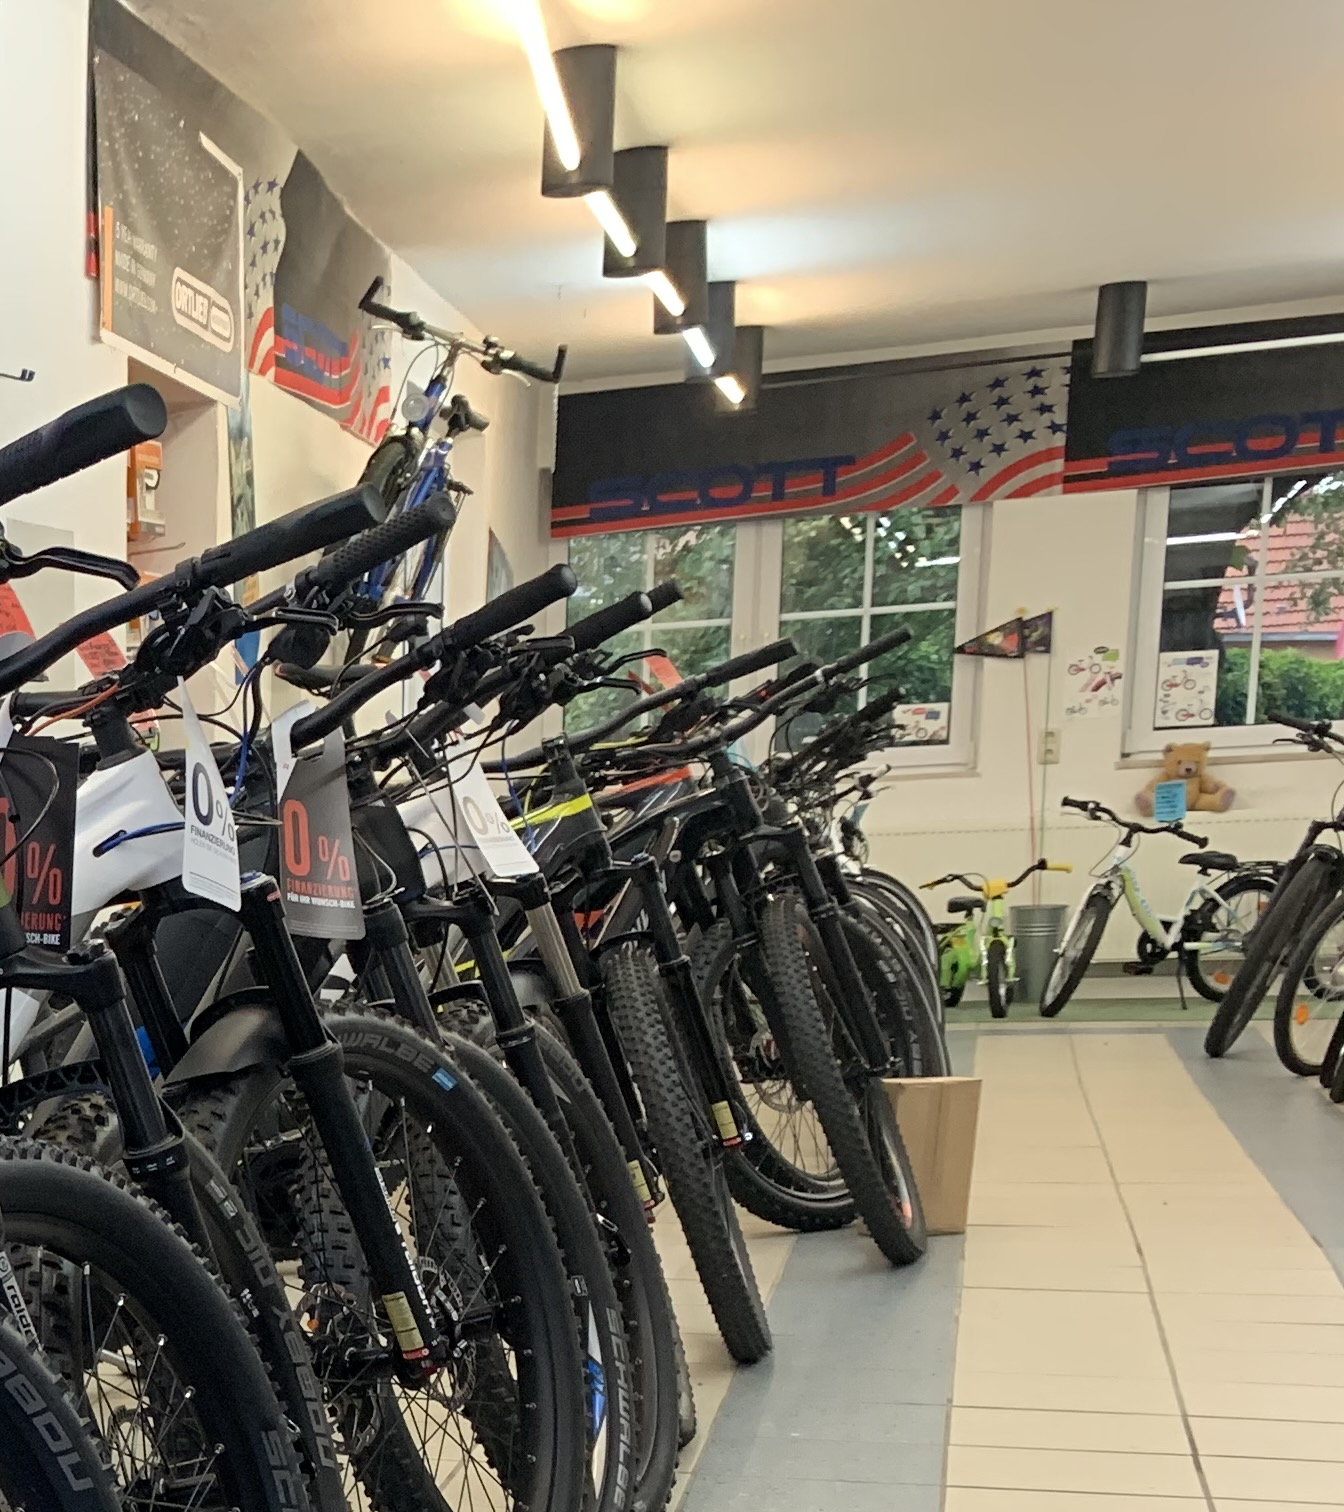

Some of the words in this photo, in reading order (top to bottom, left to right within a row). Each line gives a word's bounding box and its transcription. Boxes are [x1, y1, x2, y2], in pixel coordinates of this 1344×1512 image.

[587, 454, 857, 522] SCOTT
[192, 761, 213, 826] 0
[26, 841, 63, 906] %
[282, 800, 310, 877] 0
[318, 835, 351, 883] %
[286, 877, 355, 899] FINANZIERUNG
